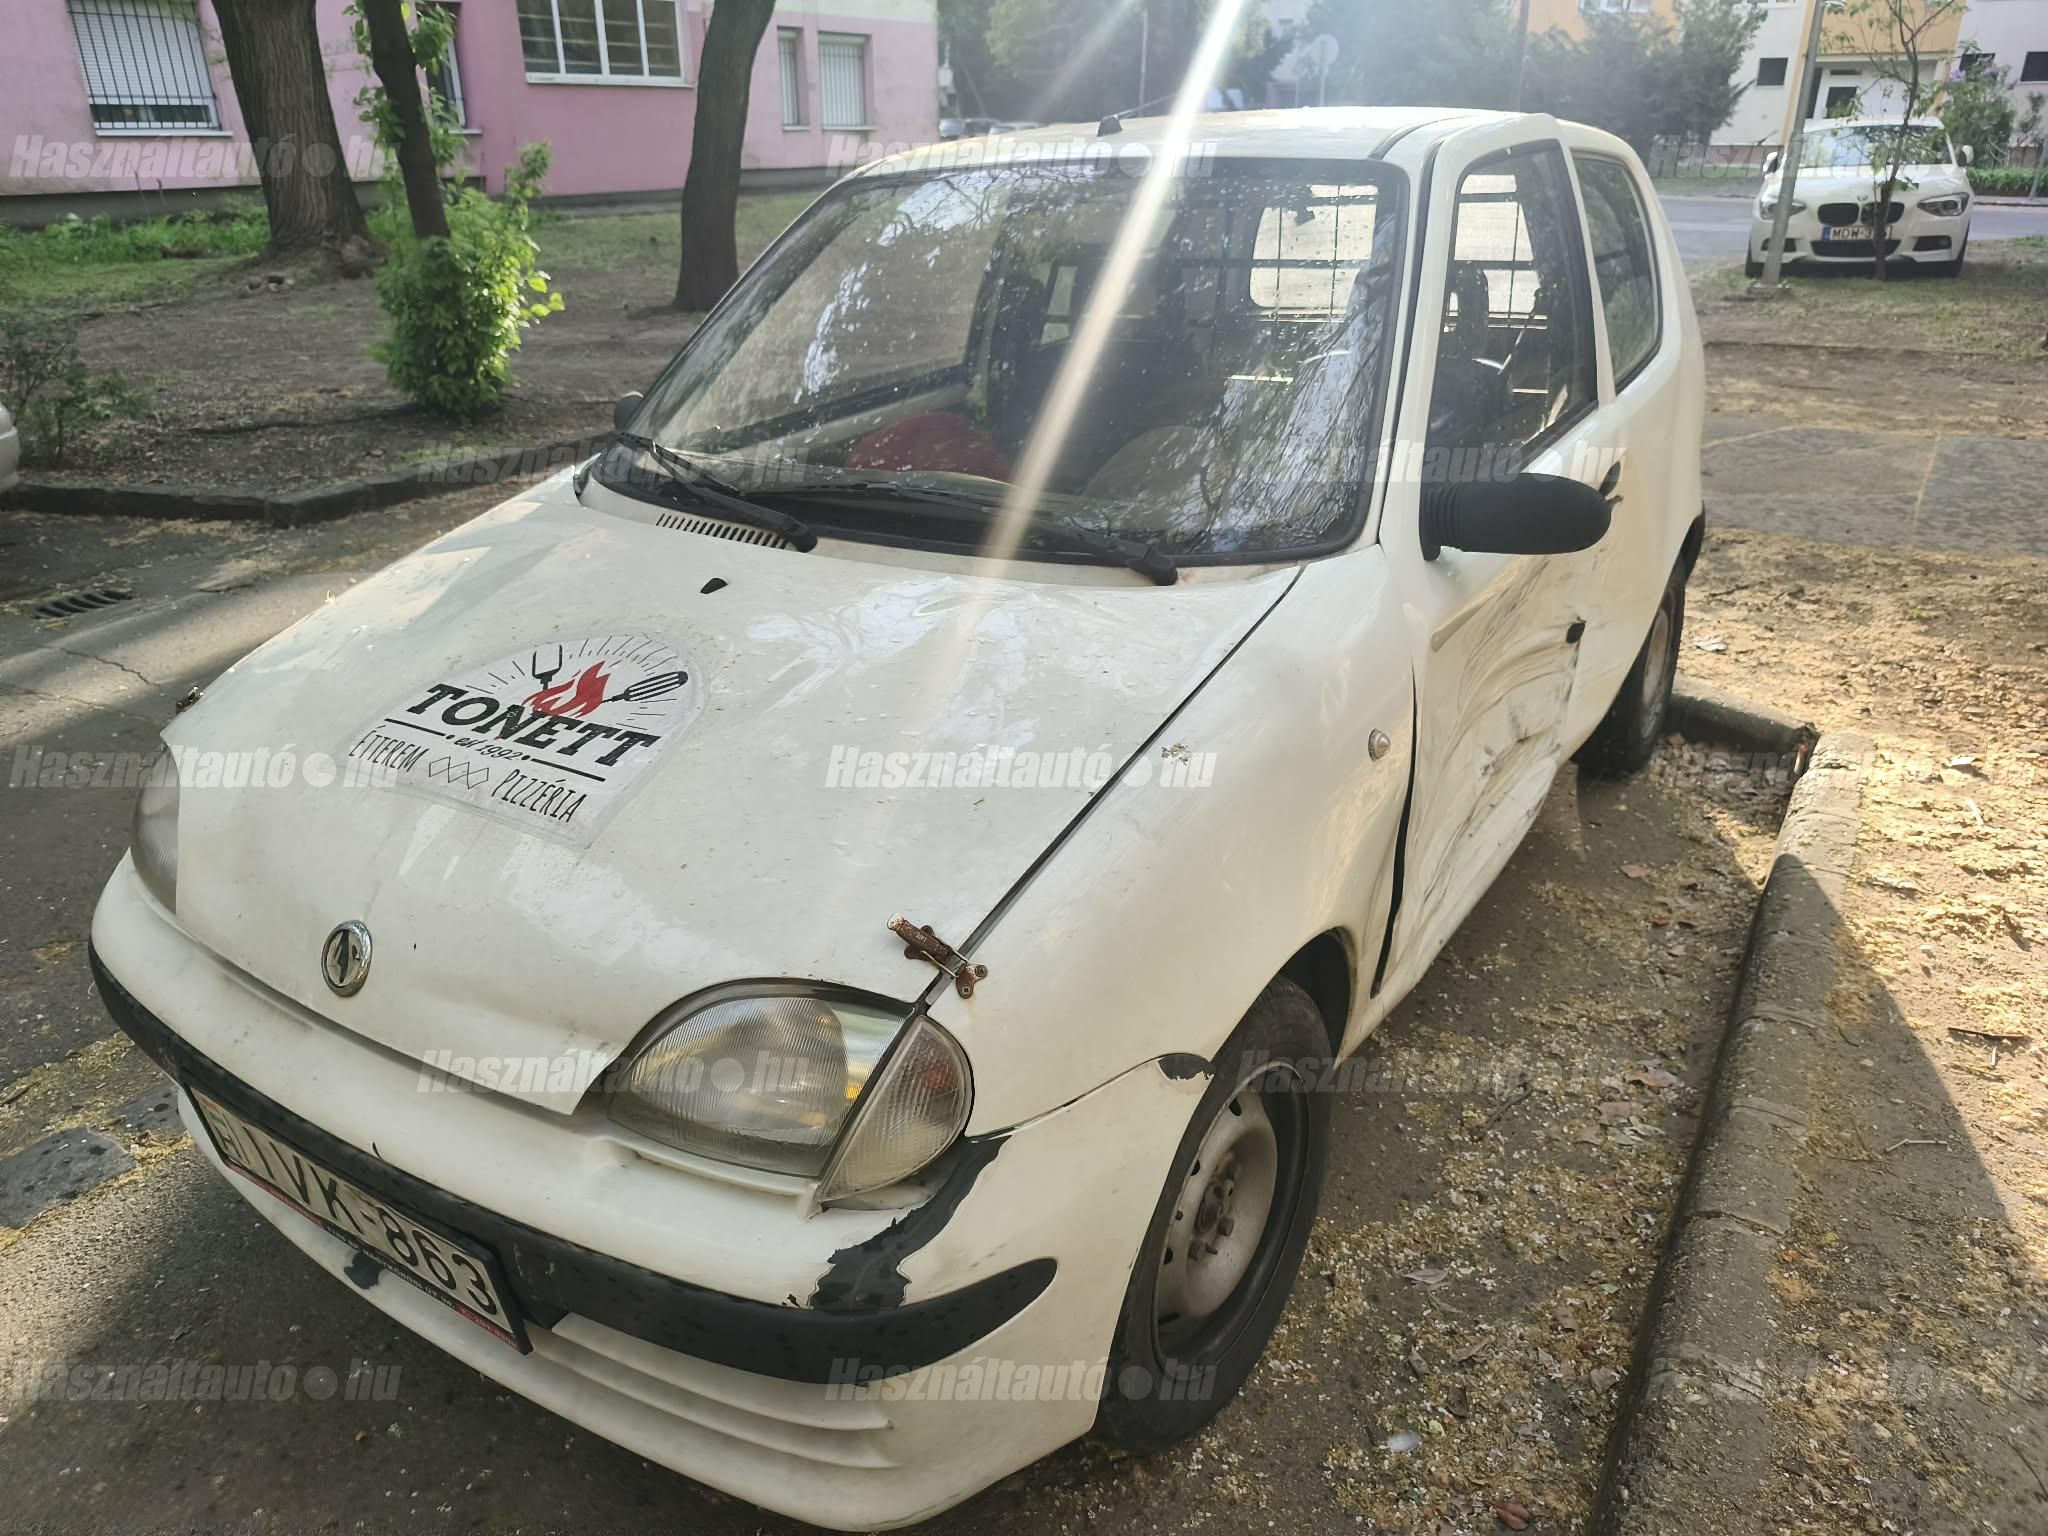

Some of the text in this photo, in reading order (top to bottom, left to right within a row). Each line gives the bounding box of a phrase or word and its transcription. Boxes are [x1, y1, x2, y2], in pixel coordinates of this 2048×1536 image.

[349, 725, 430, 773] ÉTTEREM
[406, 683, 661, 767] TONETT
[481, 741, 523, 761] 1992
[491, 768, 588, 823] PIZZÉRIA
